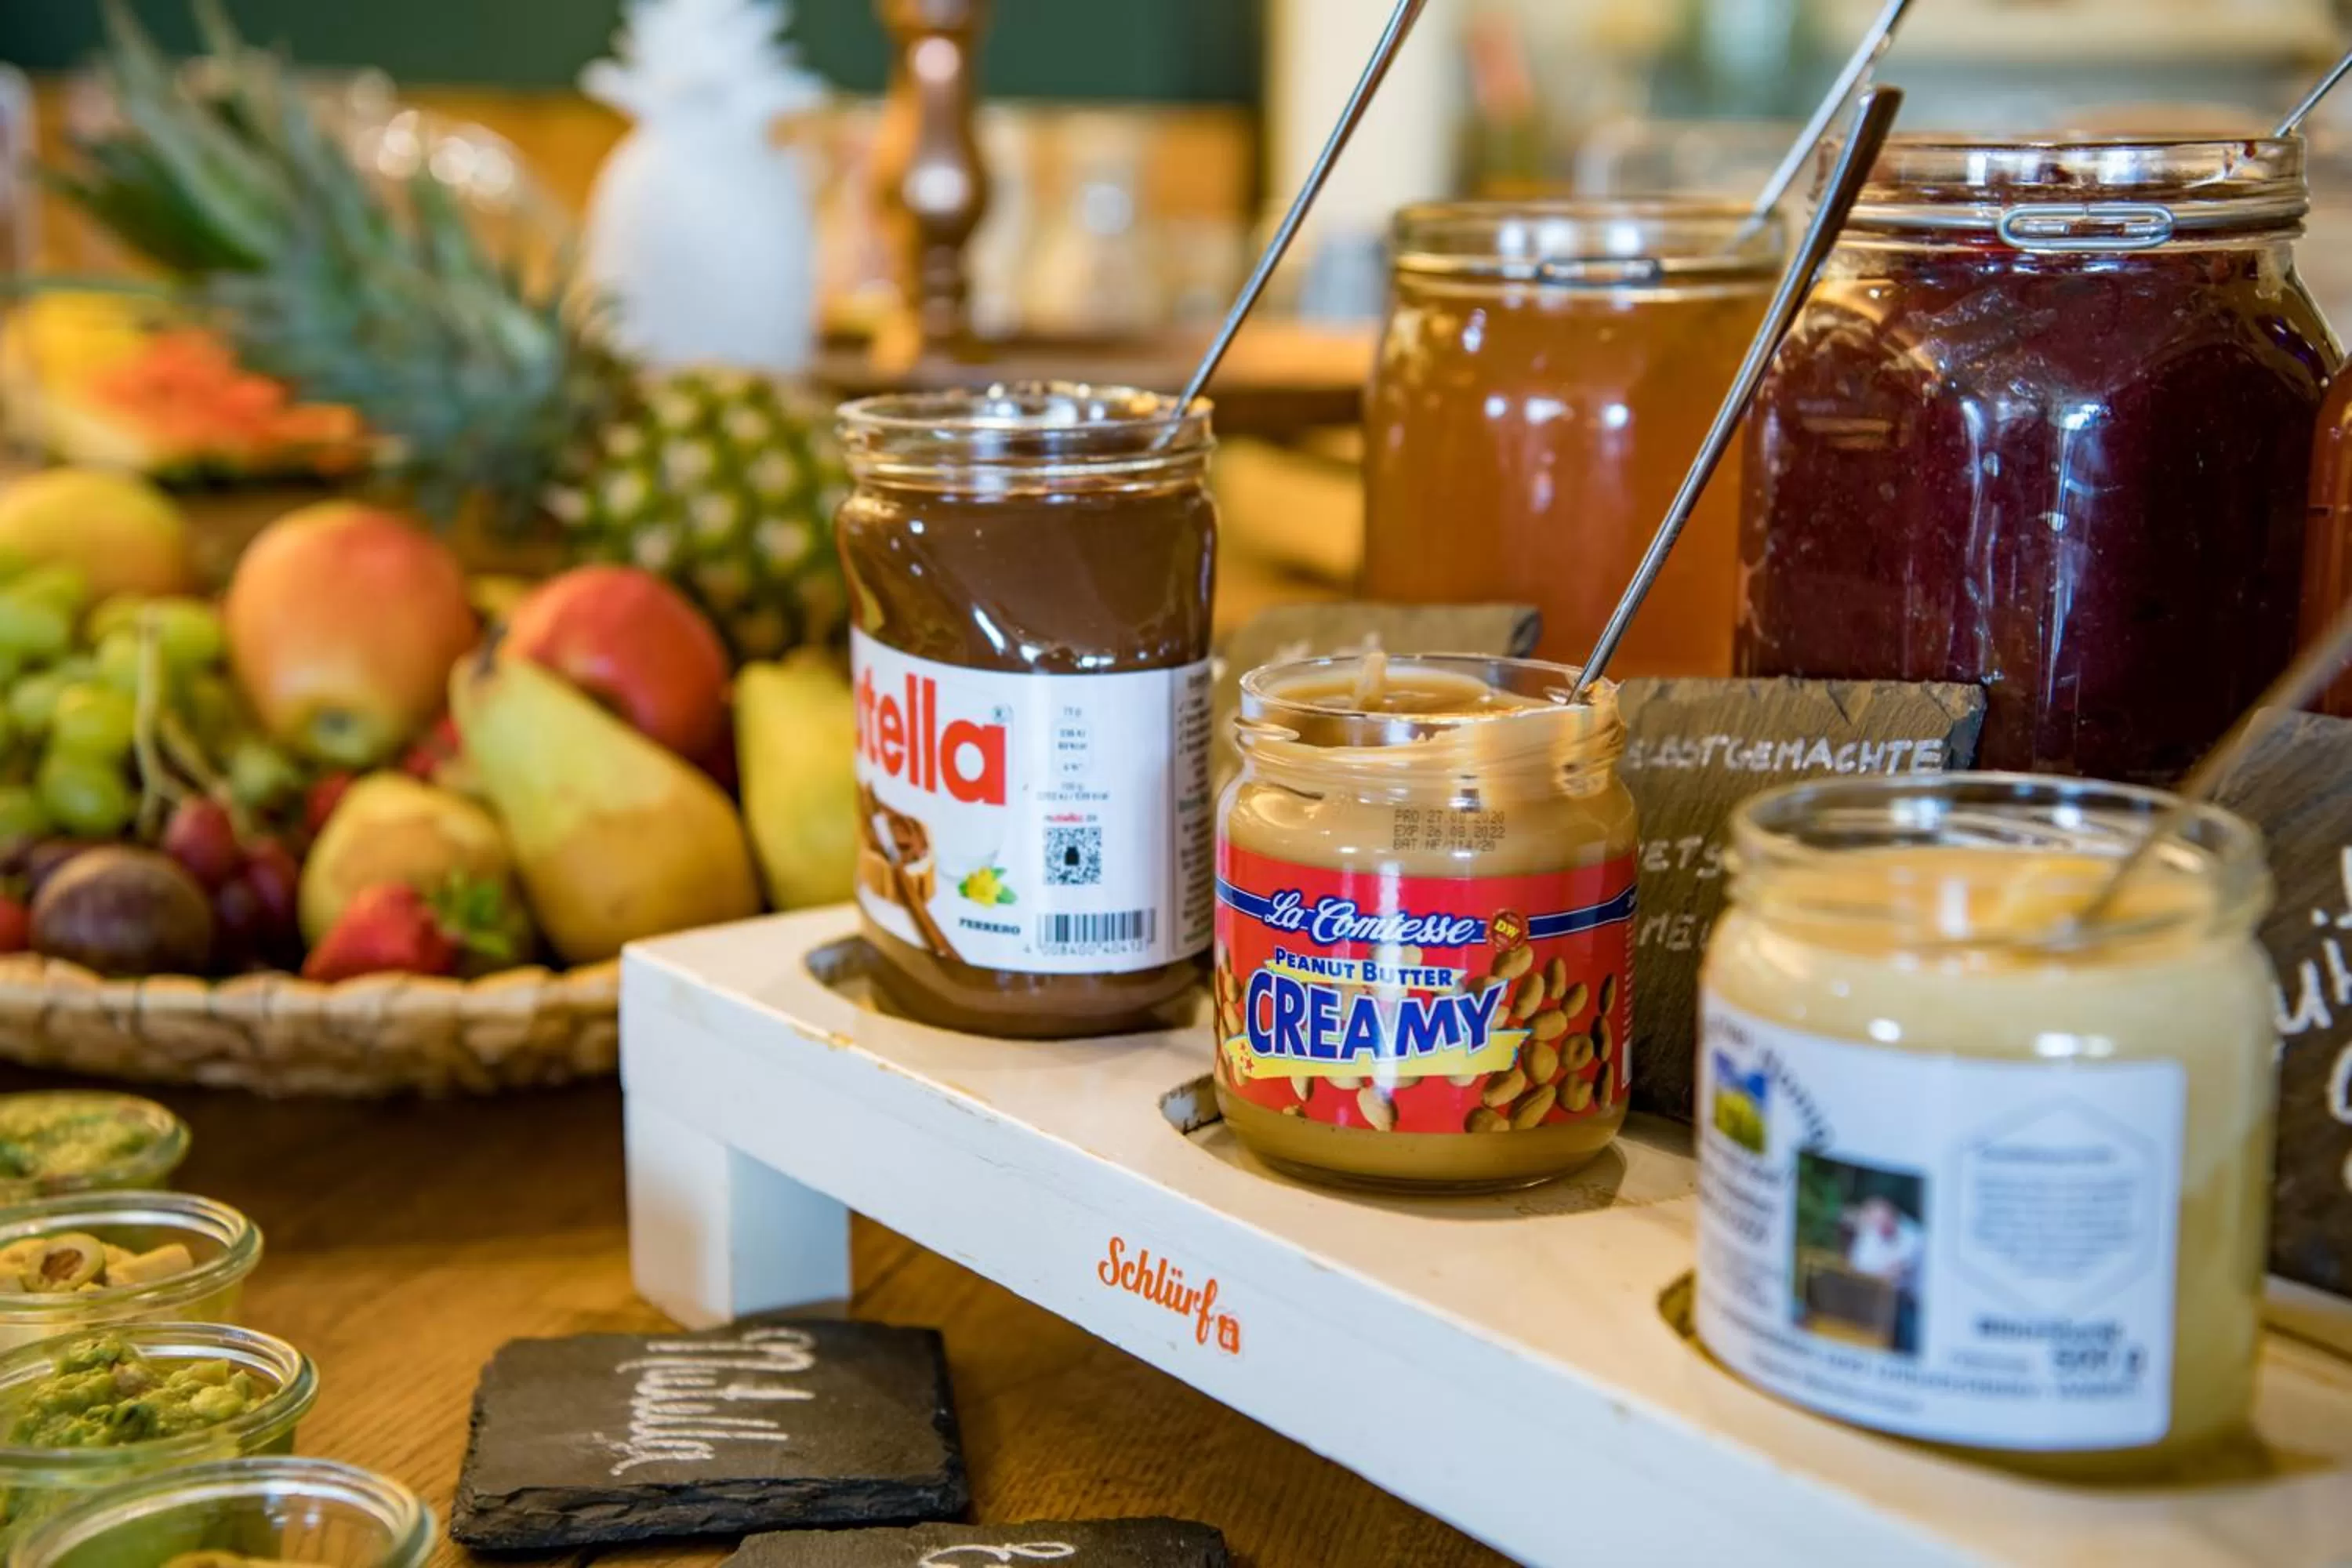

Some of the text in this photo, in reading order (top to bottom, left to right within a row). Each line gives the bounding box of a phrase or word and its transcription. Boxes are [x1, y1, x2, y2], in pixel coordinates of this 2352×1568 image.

[855, 666, 1005, 806] tella
[1394, 824, 1419, 837] EXP
[1265, 892, 1477, 942] La Comtesse
[1276, 947, 1356, 979] PEANUT
[1247, 970, 1507, 1060] CREAMY
